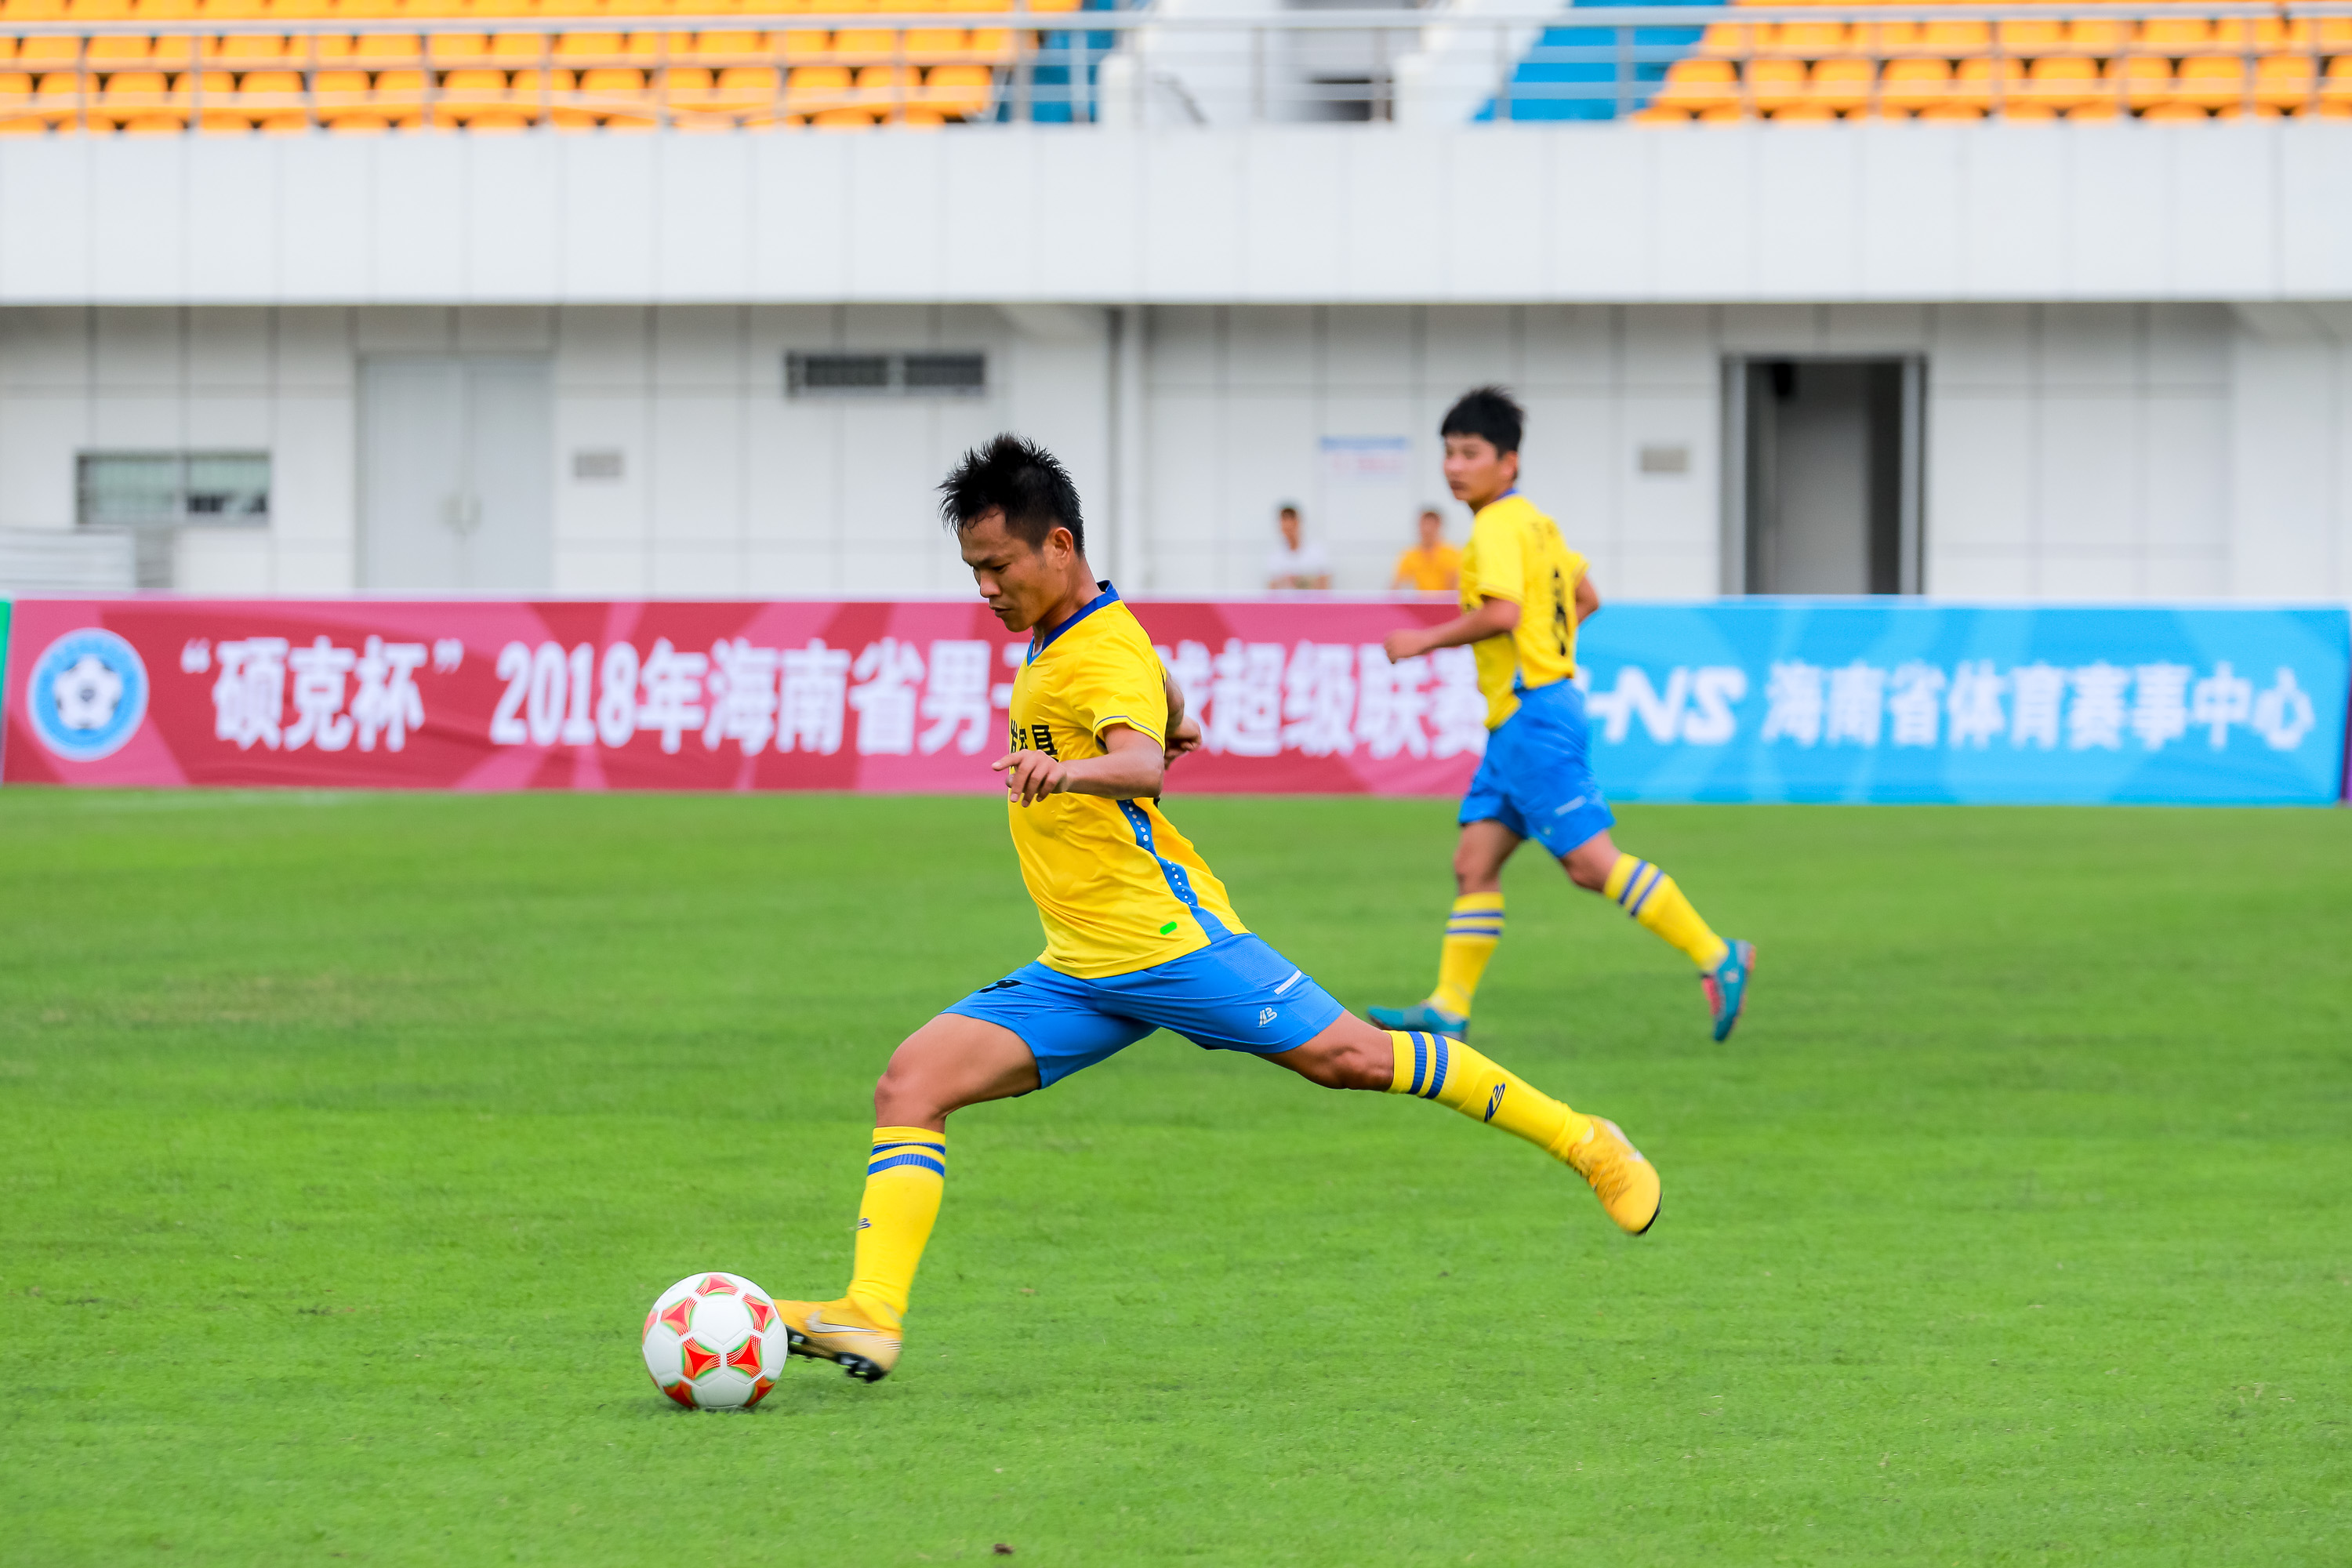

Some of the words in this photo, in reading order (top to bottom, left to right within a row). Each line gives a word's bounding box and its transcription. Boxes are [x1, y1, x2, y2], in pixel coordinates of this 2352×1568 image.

[1762, 661, 2315, 750] 海南省体育赛事中心
